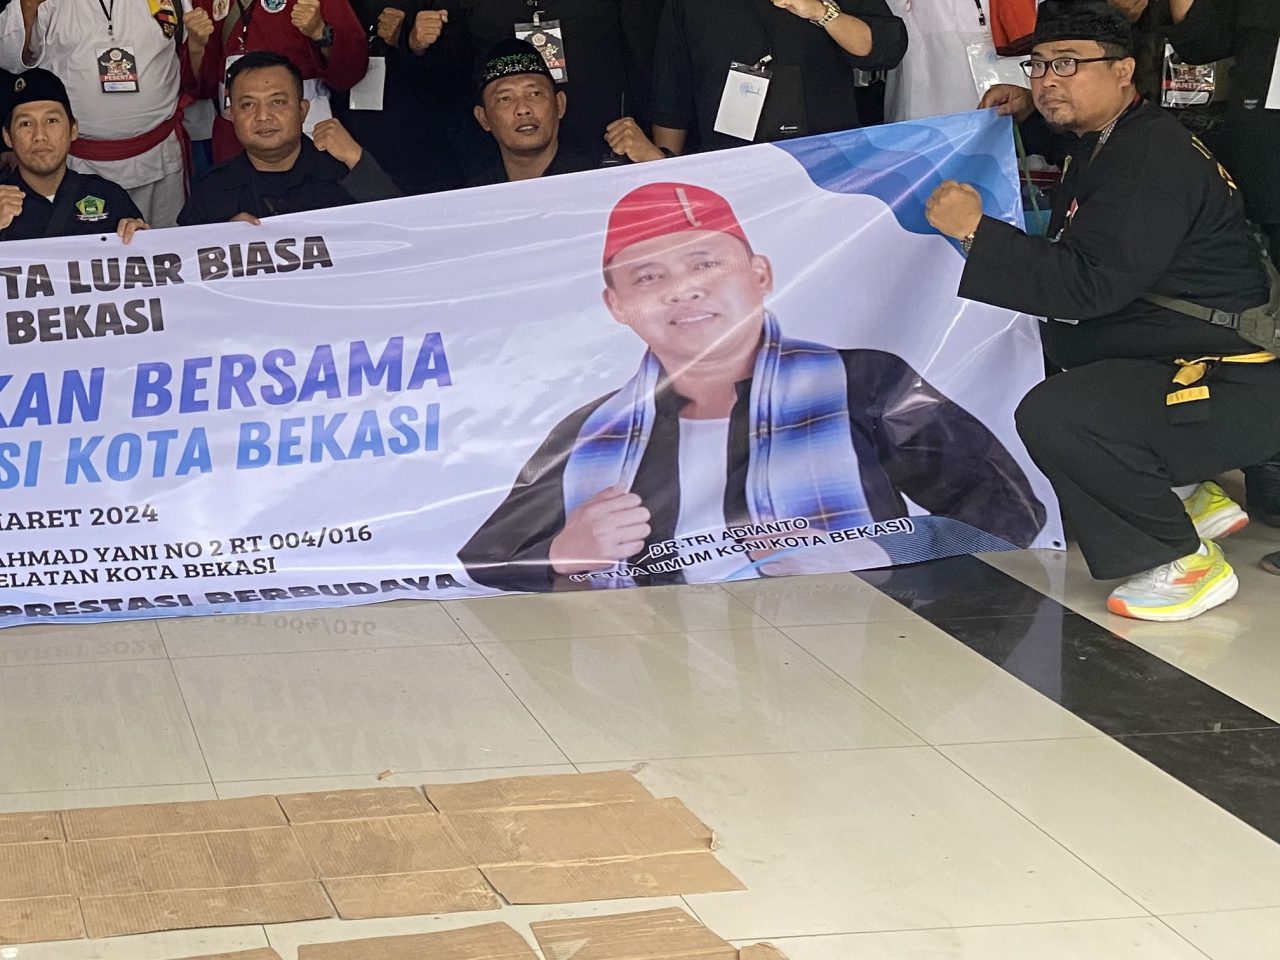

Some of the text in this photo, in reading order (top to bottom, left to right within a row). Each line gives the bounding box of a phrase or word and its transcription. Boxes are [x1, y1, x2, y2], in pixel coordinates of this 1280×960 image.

[1170, 82, 1214, 90] PANIT
[67, 252, 186, 295] LUAR
[196, 235, 334, 282] BIASA
[5, 297, 165, 345] BEKASI
[130, 331, 454, 419] BERSAMA
[64, 426, 214, 486] KOTA
[236, 402, 441, 472] BEKASI
[89, 503, 160, 527] 2024
[721, 517, 810, 540] ADIANTO
[93, 543, 160, 563] YANI
[164, 540, 204, 560] NO
[209, 539, 223, 557] 2
[229, 535, 263, 555] RT
[269, 524, 373, 551] 004/016
[648, 548, 717, 574] UMUM
[717, 537, 769, 557] KONI
[770, 536, 827, 550] KOTA
[828, 516, 914, 544] BEKASI)
[105, 564, 180, 584] KOTA
[182, 556, 278, 580] BEKASI
[204, 573, 467, 605] BERBUDAYA
